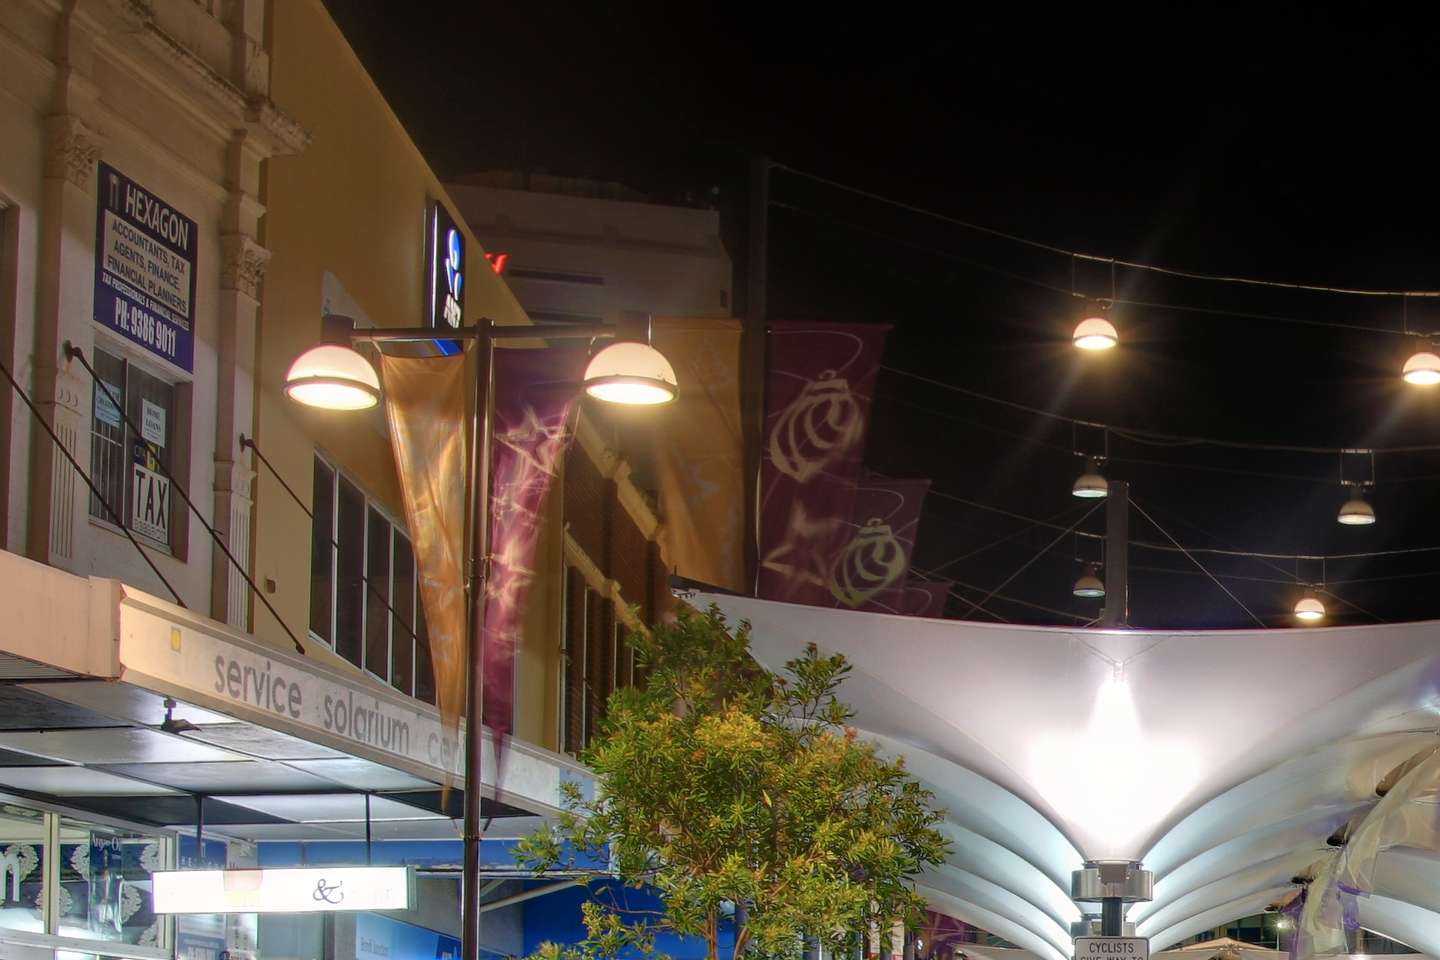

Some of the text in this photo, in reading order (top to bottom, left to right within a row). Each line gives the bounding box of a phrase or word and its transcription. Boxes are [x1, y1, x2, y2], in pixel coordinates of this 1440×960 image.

[126, 183, 188, 251] HEXAGON
[112, 219, 185, 274] ACCOUNTANTS, TAX
[114, 240, 146, 271] AGENTS,
[108, 256, 188, 313] FINANCIAL PLANNERS
[115, 297, 176, 358] PH: 9386 9011
[135, 469, 167, 529] TAX
[214, 653, 301, 720] service
[323, 694, 410, 757] solarium
[1089, 942, 1134, 953] CYCLISTS
